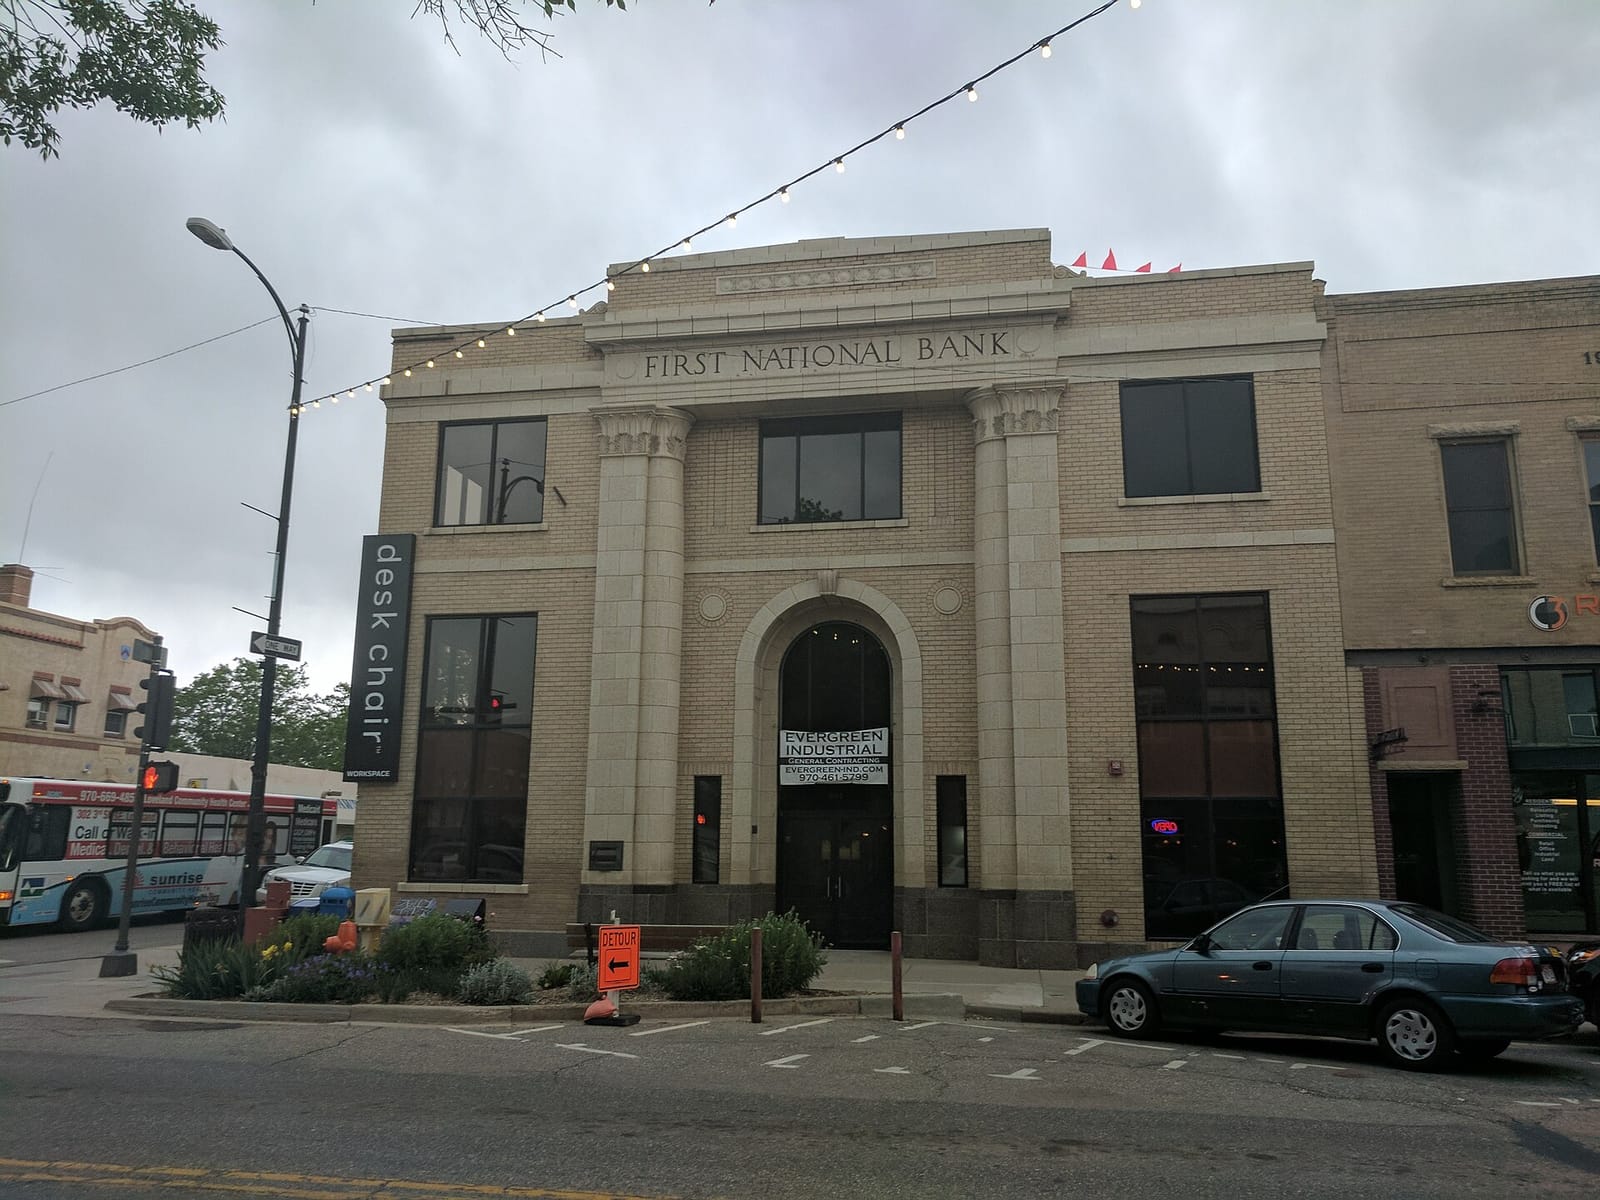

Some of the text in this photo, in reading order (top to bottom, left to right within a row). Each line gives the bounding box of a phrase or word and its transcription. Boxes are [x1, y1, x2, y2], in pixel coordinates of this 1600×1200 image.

[645, 332, 1009, 378] FIRST NATIONAL BANK
[371, 544, 402, 629] desk
[265, 640, 297, 654] ONE WAY
[363, 644, 394, 743] chair
[785, 730, 883, 743] EVERGREEN
[786, 743, 882, 756] INDUSTRIAL
[785, 765, 884, 774] EVERGREEN-IND.COM
[799, 773, 869, 782] 970-461-5799
[80, 790, 136, 803] 970-669-485
[75, 825, 99, 840] Call
[150, 872, 204, 886] sunrise
[602, 931, 637, 947] DETOUR
